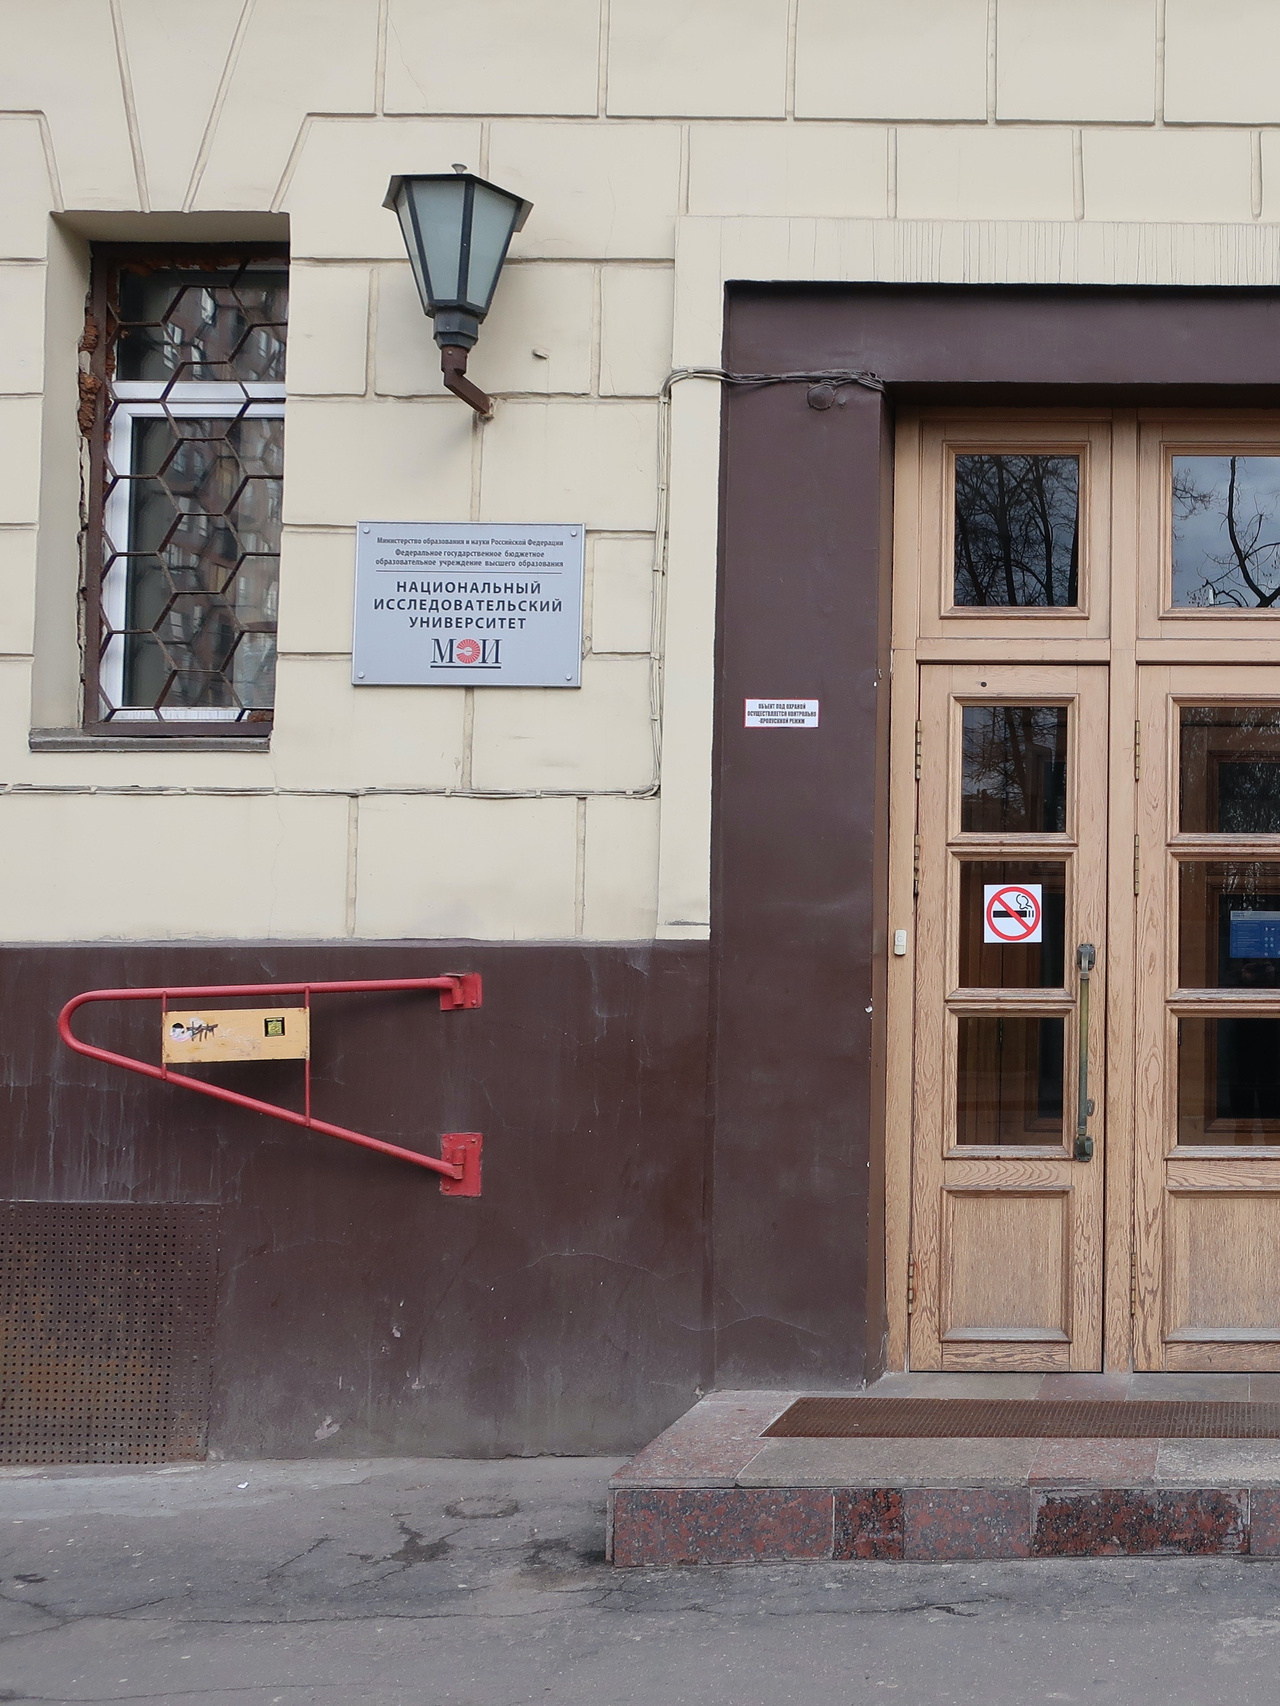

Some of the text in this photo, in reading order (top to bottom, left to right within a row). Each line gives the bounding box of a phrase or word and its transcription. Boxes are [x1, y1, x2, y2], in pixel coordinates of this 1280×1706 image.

[395, 549, 442, 557] Федеральное
[505, 550, 544, 558] бюджетное
[376, 558, 436, 566] образовательное
[397, 581, 541, 595] НАЦИОНАЛЬНЫЙ
[374, 598, 562, 613] ИССЛЕДОВАТЕЛЬСКИЙ
[409, 616, 526, 629] УНИВЕРСИТЕТ
